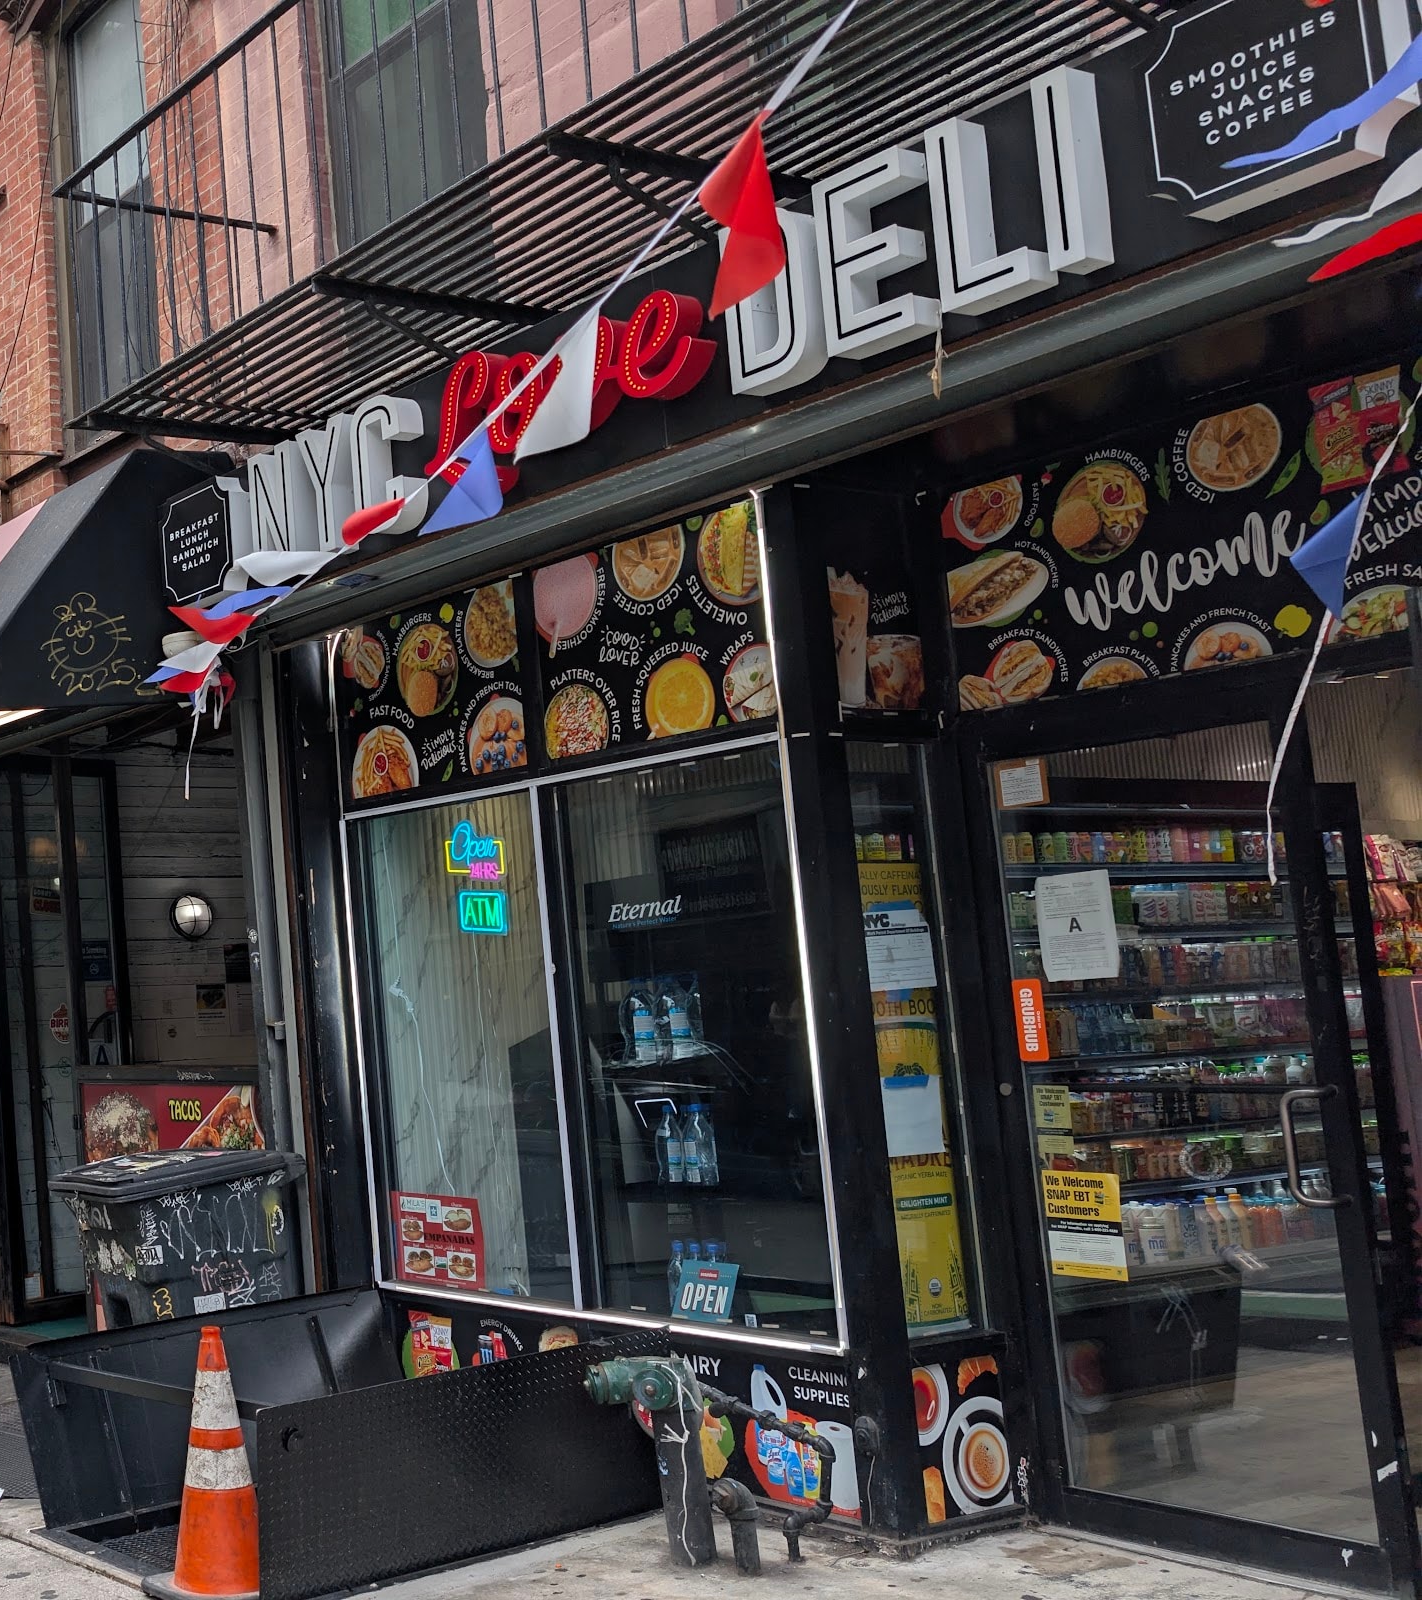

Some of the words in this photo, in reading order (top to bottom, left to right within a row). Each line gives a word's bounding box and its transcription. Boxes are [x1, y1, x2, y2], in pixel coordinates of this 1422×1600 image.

[1169, 10, 1336, 96] SMOOTHIES
[1210, 51, 1297, 100] JUICE
[1198, 66, 1315, 127] SNACKS
[1206, 89, 1313, 145] COFFEE
[248, 395, 428, 552] NYC
[717, 64, 1115, 396] DELI
[1365, 379, 1394, 395] SKINNY
[1084, 448, 1150, 483] HAMBURGERS
[1173, 428, 1190, 483] COFFEE
[1031, 482, 1040, 503] FAST
[1185, 481, 1216, 504] ICED
[169, 512, 219, 542] BREAKFAST
[1024, 503, 1039, 527] FOOD
[172, 537, 219, 564] SANDWICH
[180, 529, 209, 548] LUNCH
[182, 553, 211, 572] SALAD
[1014, 540, 1031, 549] HOT
[1031, 541, 1059, 589] SANDWICHES
[1343, 563, 1397, 590] FRESH
[596, 566, 606, 607] FRESH
[656, 583, 683, 611] ICED
[685, 575, 748, 626] OMELETTES
[612, 591, 655, 616] COFFEE
[391, 612, 432, 657] HAMBURGERS
[455, 609, 465, 655] PLATTERS
[556, 610, 602, 651] SMOOTHIES
[1170, 626, 1191, 672] PANCAKES
[1189, 613, 1208, 630] AND
[1208, 608, 1246, 619] FRENCH
[1246, 611, 1272, 633] TOAST
[680, 641, 710, 662] JUICE
[719, 630, 755, 667] WRAPS
[987, 628, 1034, 651] BREAKFAST
[1034, 630, 1068, 683] SANDWICHES
[1082, 645, 1130, 668] BREAKFAST
[58, 658, 137, 696] 2025
[460, 655, 495, 679] BREAKFAST
[636, 642, 679, 687] SQUEEZED
[369, 704, 389, 719] FAST
[391, 705, 415, 730] FOOD
[549, 668, 596, 691] PLATTERS
[595, 677, 617, 709] OVER
[610, 710, 622, 742] RICE
[631, 688, 642, 730] FRESH
[459, 719, 468, 773] PANCAKES
[466, 700, 477, 719] AND
[475, 681, 504, 701] FRENCH
[451, 822, 497, 866] Open
[469, 862, 498, 880] 24HRS
[465, 896, 500, 927] ATM
[608, 895, 682, 923] Eternal
[1069, 917, 1082, 933] A
[1019, 988, 1039, 1052] GRUBHUB
[168, 1099, 202, 1121] TACOS
[1044, 1174, 1060, 1187] We
[1061, 1176, 1104, 1189] Welcome
[1046, 1188, 1071, 1201] SNAP
[1073, 1190, 1090, 1202] EBT
[900, 1198, 933, 1208] ENLIGHTEN
[933, 1196, 948, 1205] MINT
[1047, 1202, 1100, 1217] Customers
[423, 1232, 475, 1245] EMPANADAS
[680, 1282, 729, 1314] OPEN
[433, 1326, 449, 1336] SKINNY
[480, 1318, 503, 1328] ENERGY
[503, 1324, 524, 1352] DRINKS
[793, 1385, 850, 1409] SUPPLIES
